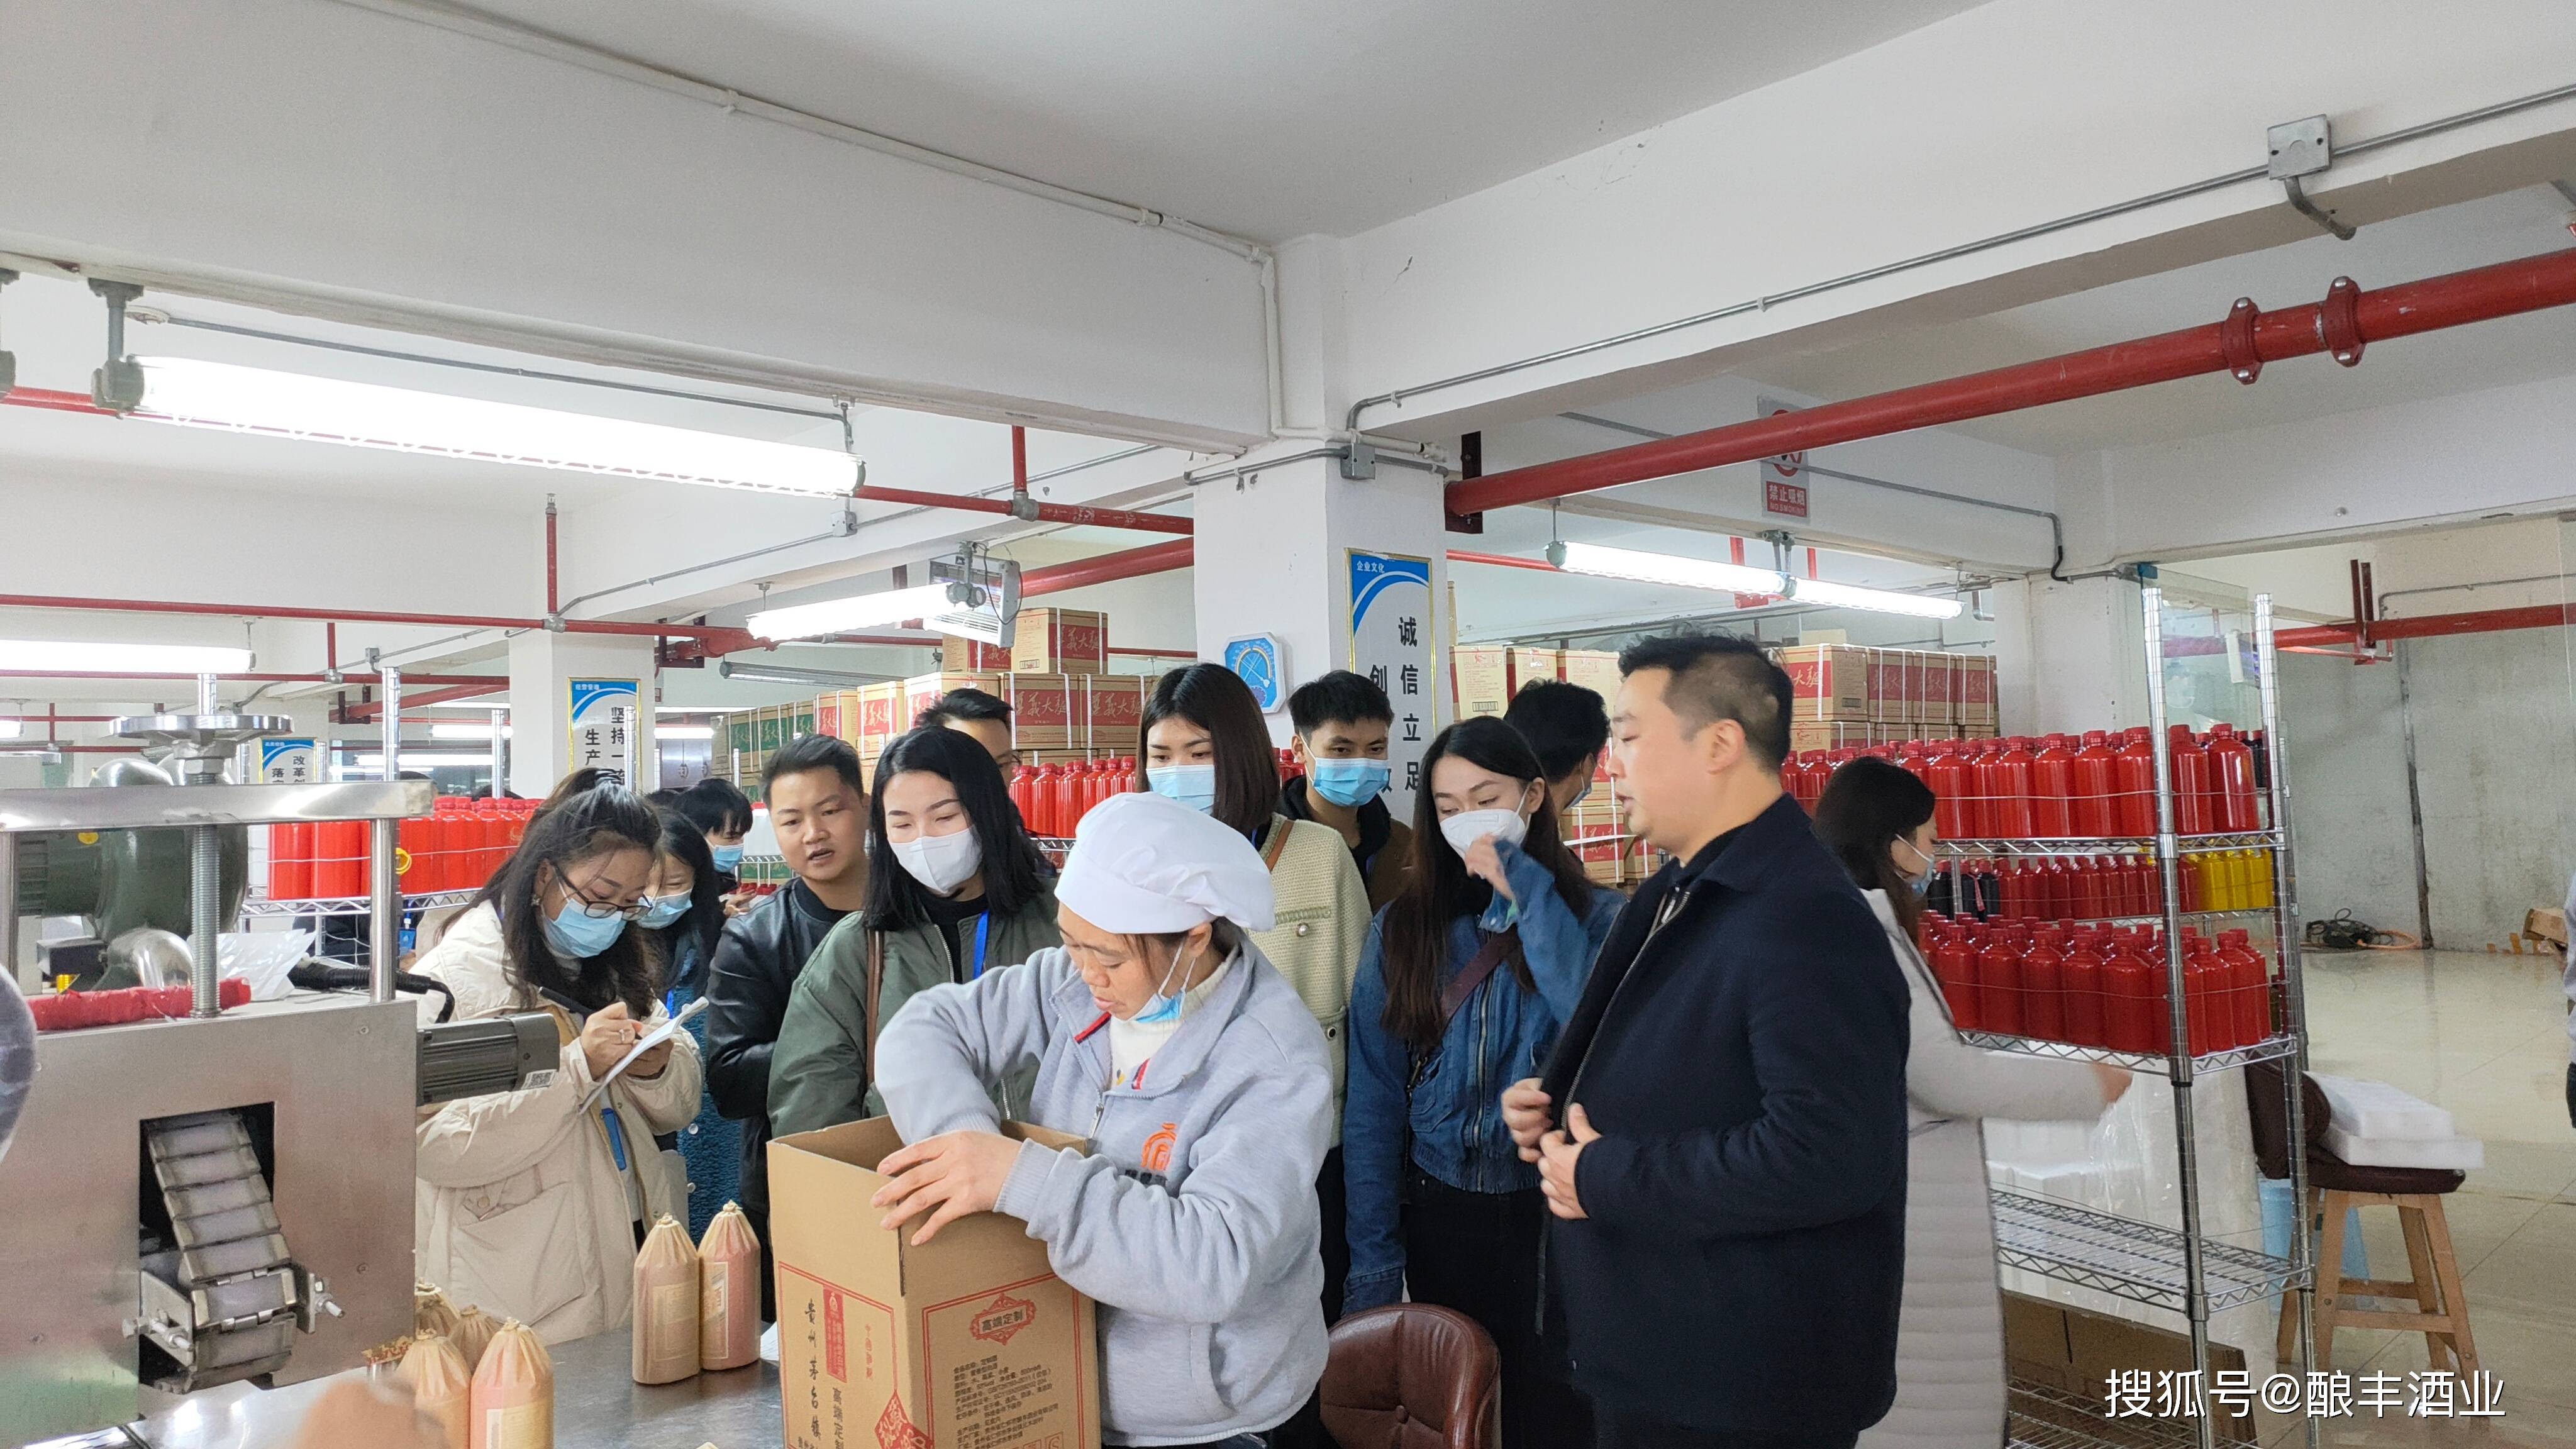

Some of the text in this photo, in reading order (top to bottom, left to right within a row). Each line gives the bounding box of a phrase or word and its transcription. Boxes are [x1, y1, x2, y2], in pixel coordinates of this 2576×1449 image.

[1769, 484, 1805, 506] 禁止吸烟
[1357, 560, 1385, 573] 企业文化
[1398, 616, 1421, 790] 诚信立足
[585, 728, 601, 765] 生产
[272, 768, 285, 783] 落
[982, 1309, 1023, 1333] 高端定制
